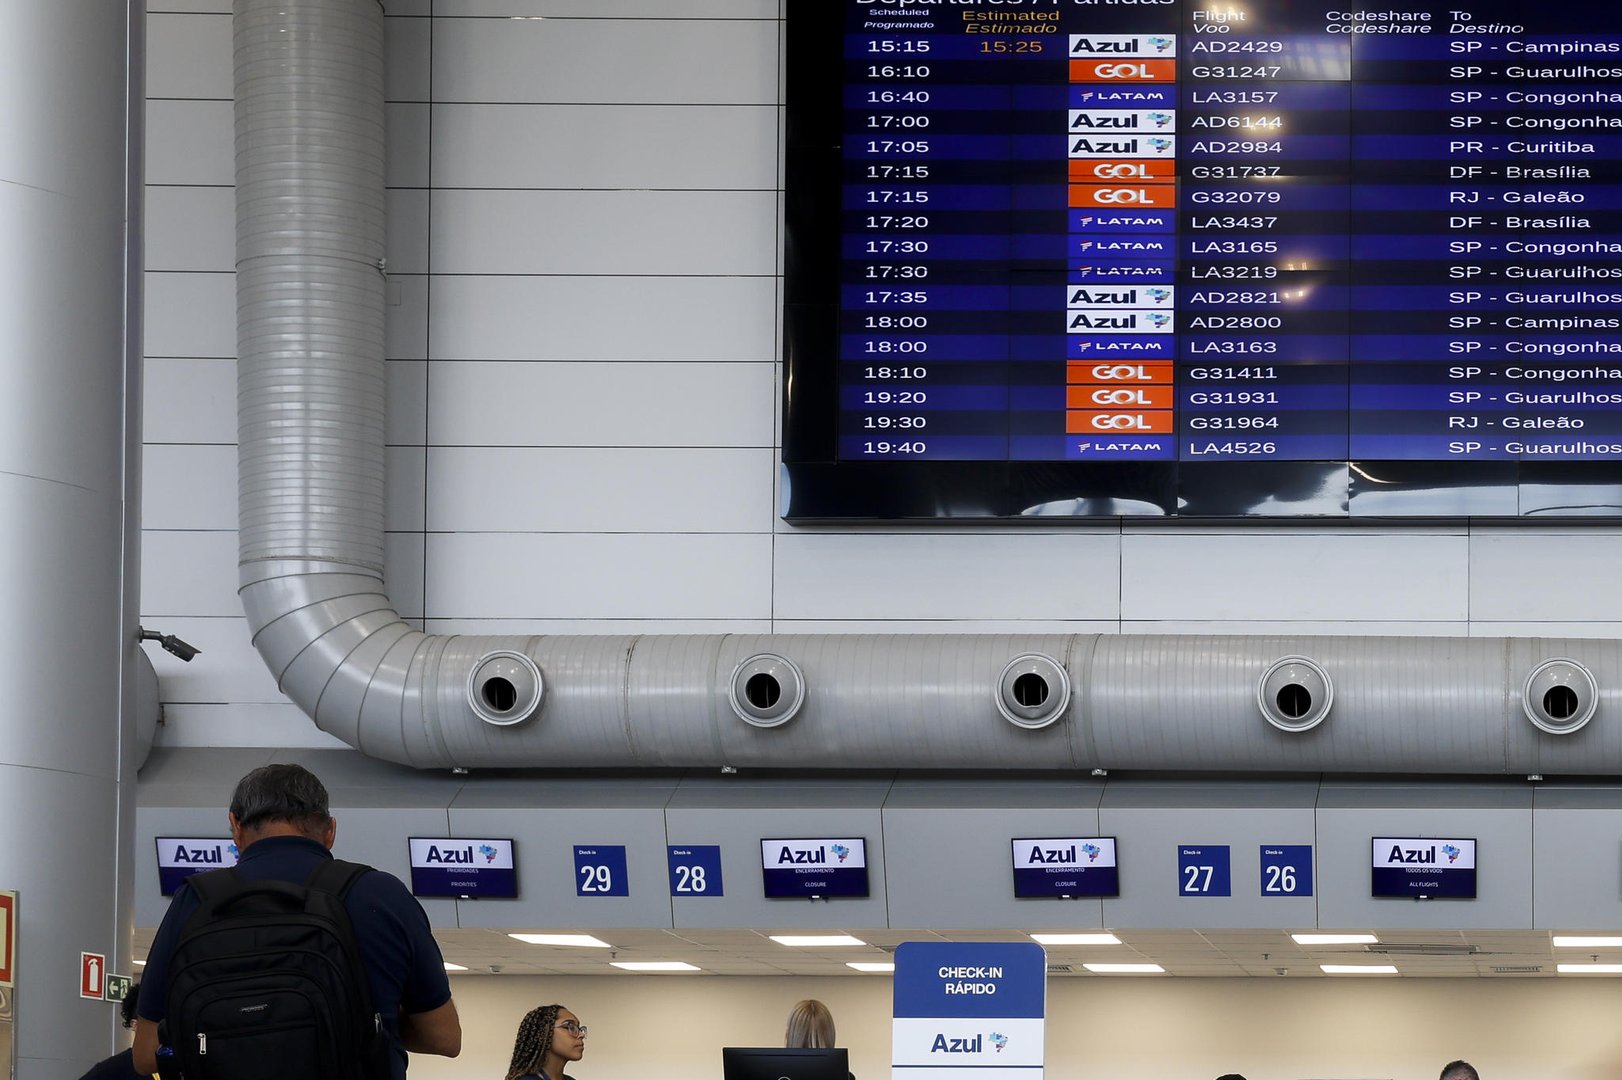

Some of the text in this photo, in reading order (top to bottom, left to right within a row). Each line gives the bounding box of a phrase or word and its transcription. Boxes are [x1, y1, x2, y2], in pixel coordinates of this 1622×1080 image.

[870, 6, 929, 15] Scheduled
[963, 11, 1059, 20] Estimated
[1193, 10, 1246, 23] Flight
[1326, 11, 1431, 22] Codeshare
[1450, 11, 1471, 20] To
[966, 23, 1056, 33] Estimado
[1193, 24, 1230, 34] Voo
[1326, 22, 1431, 34] Codeshare
[1450, 23, 1523, 33] Destino
[869, 41, 929, 52] 15:15
[981, 42, 1042, 52] 15:25
[1072, 38, 1138, 53] Azul
[1191, 41, 1283, 53] AD2429
[1450, 42, 1482, 52] SP
[1507, 41, 1619, 55] Campinas
[868, 91, 929, 102] 16:40
[1097, 92, 1164, 100] LATAM
[1193, 92, 1278, 103] LA3157
[1451, 92, 1482, 102] SP
[867, 191, 928, 202] 17:15
[1093, 188, 1154, 204] GOL
[1192, 192, 1280, 203] G32079
[1451, 192, 1478, 203] RJ
[1503, 192, 1584, 202] Galeão
[174, 845, 222, 863] Azul
[426, 846, 473, 863] Azul
[778, 846, 825, 863] Azul
[1029, 846, 1076, 863] Azul
[1388, 846, 1435, 863] Azul
[581, 866, 611, 891] 29
[676, 866, 705, 892] 28
[1185, 866, 1213, 891] 27
[1267, 866, 1295, 892] 26
[939, 967, 1002, 978] CHECK-IN
[946, 981, 995, 994] RÁPIDO
[931, 1034, 981, 1053] Azul
